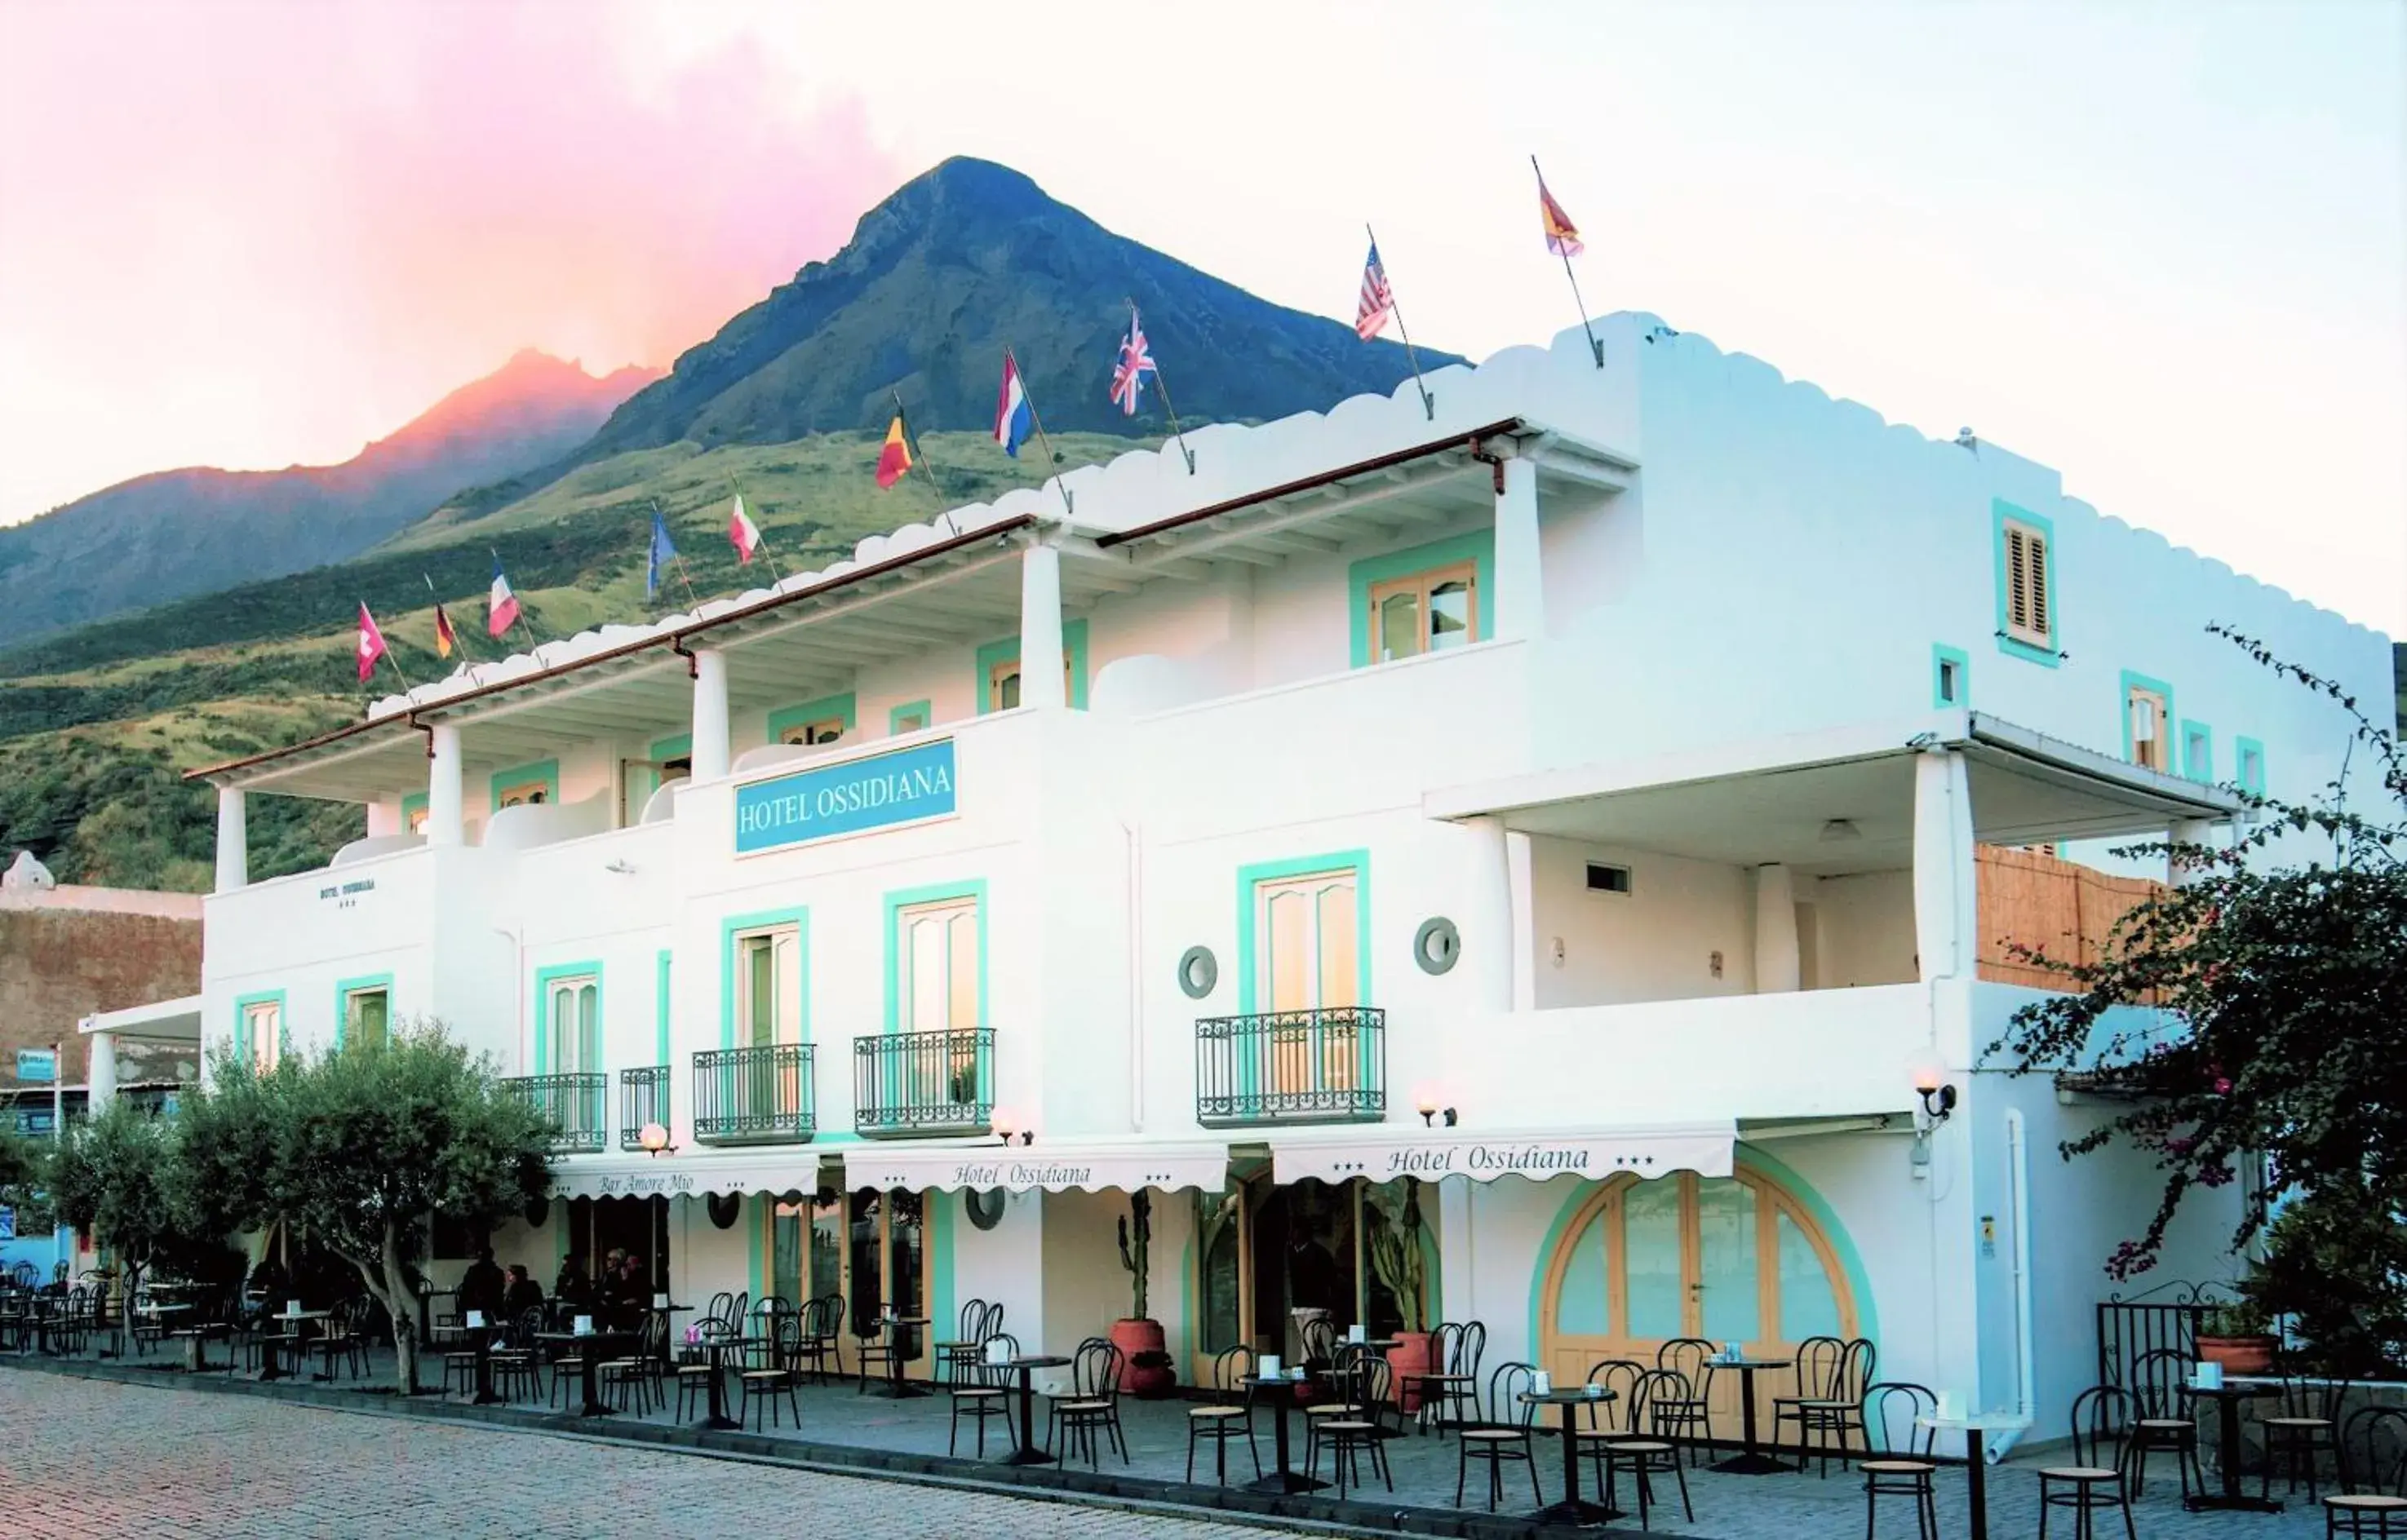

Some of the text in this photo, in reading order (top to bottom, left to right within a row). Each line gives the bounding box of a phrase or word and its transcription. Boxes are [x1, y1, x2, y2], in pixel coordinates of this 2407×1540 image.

[740, 764, 951, 834] HOTEL OSSIDIANA
[1388, 1144, 1589, 1171] Hotel Ossidiana
[599, 1173, 694, 1193] Bar Amore Mio
[953, 1162, 1091, 1184] Hotel Ossidiana
